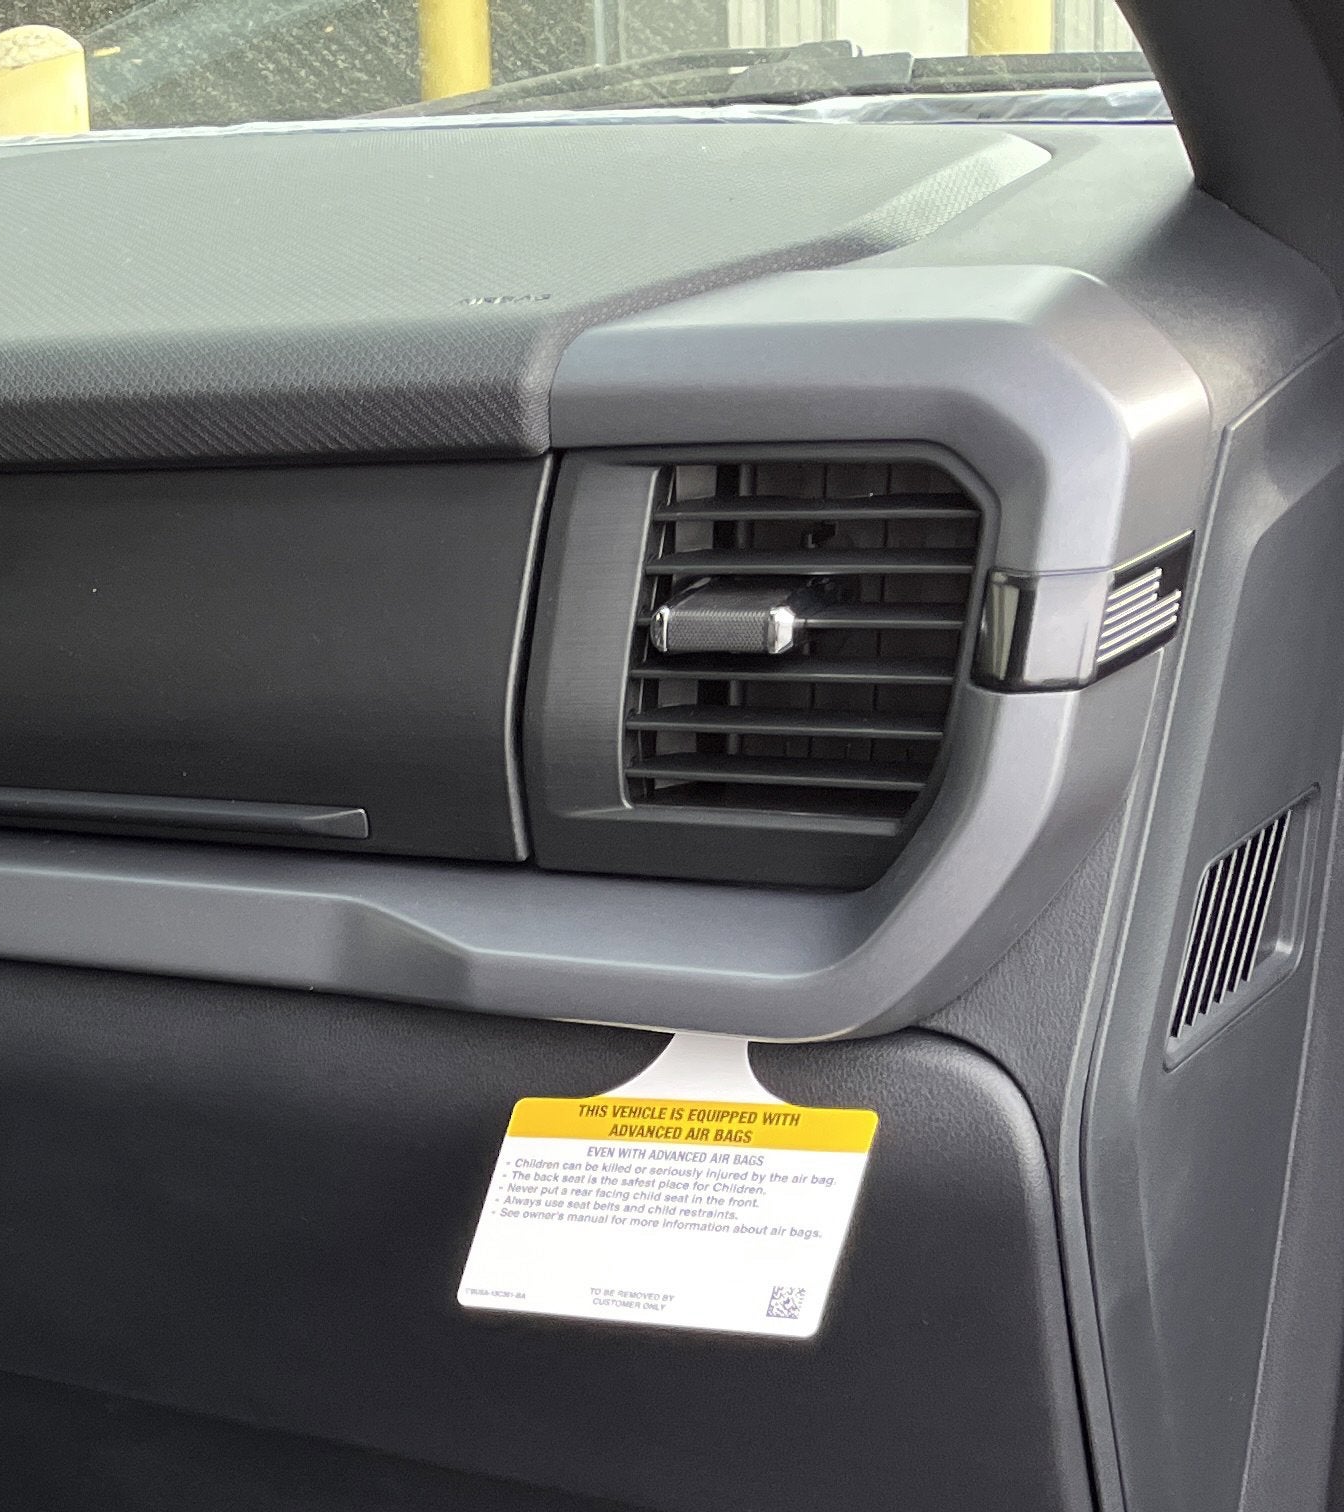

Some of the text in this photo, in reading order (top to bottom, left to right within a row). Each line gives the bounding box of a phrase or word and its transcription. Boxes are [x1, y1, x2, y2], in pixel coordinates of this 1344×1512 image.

[578, 1104, 801, 1127] THIS VEHICLE IS EQUIPPED WITH
[608, 1123, 754, 1144] ADVANCED AIR BAGS
[586, 1146, 765, 1167] EVEN WITH ADVANCED AIR BAGS
[512, 1170, 767, 1195] The back seat is the safest place for Children.
[514, 1158, 837, 1188] Children can be killed or seriously injured by the air bag.
[503, 1195, 738, 1220] Always use seat belts and child restraints.
[506, 1183, 760, 1208] Never put a rear facing child seat in the front.
[499, 1207, 822, 1240] See owner's manual for more information about air bags.
[590, 1287, 675, 1302] TO BE REMOVED BY
[592, 1297, 667, 1311] CUSTOMER ONLY
